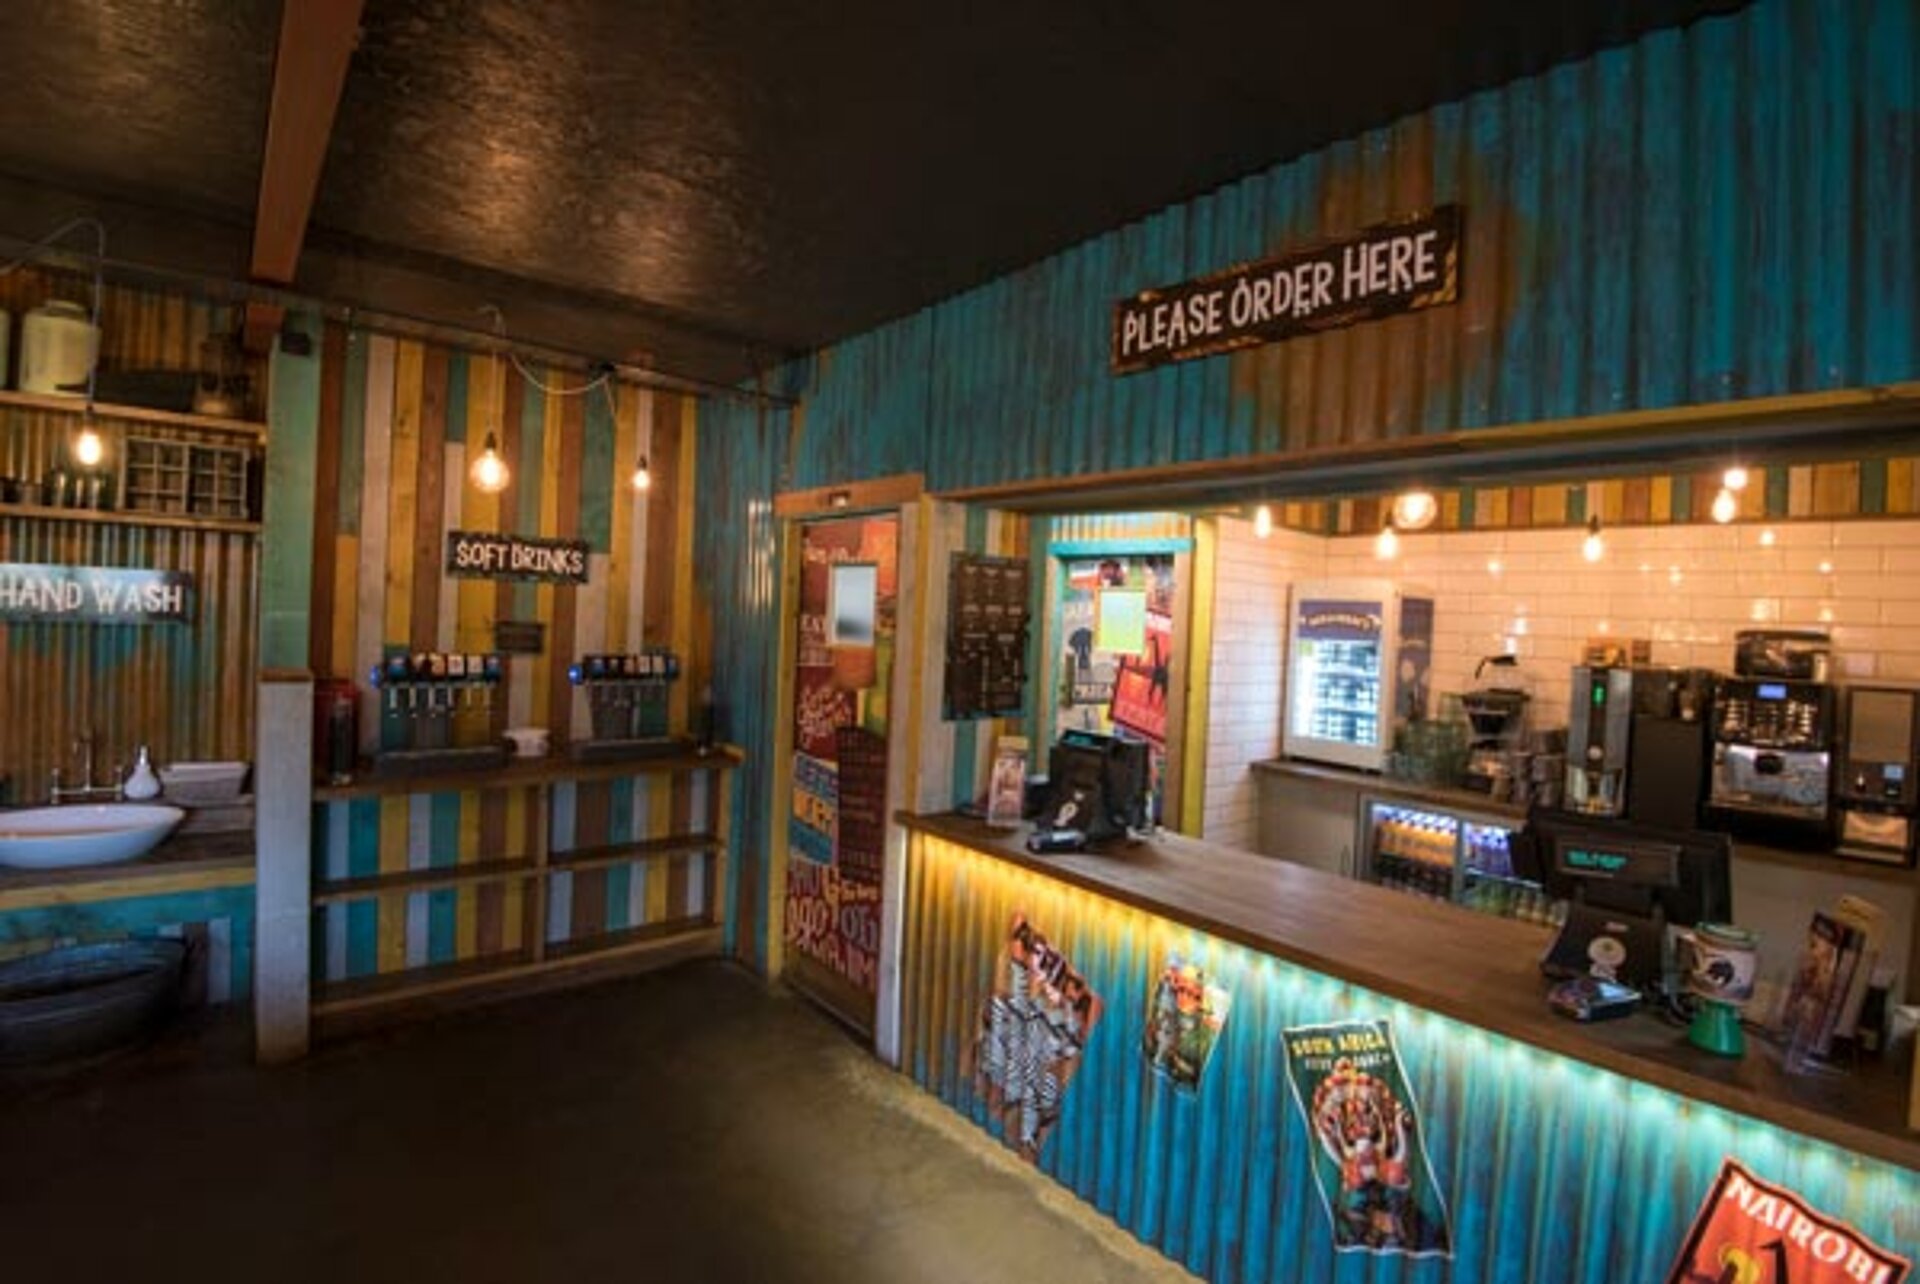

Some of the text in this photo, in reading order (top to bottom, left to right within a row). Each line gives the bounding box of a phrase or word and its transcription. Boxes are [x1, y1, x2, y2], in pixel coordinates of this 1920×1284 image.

[1122, 230, 1438, 355] PLEASE ORDER HERE
[0, 574, 183, 615] HAND WASH
[456, 540, 584, 575] SOFT DRINKS
[1726, 1173, 1893, 1284] NAIROBI
